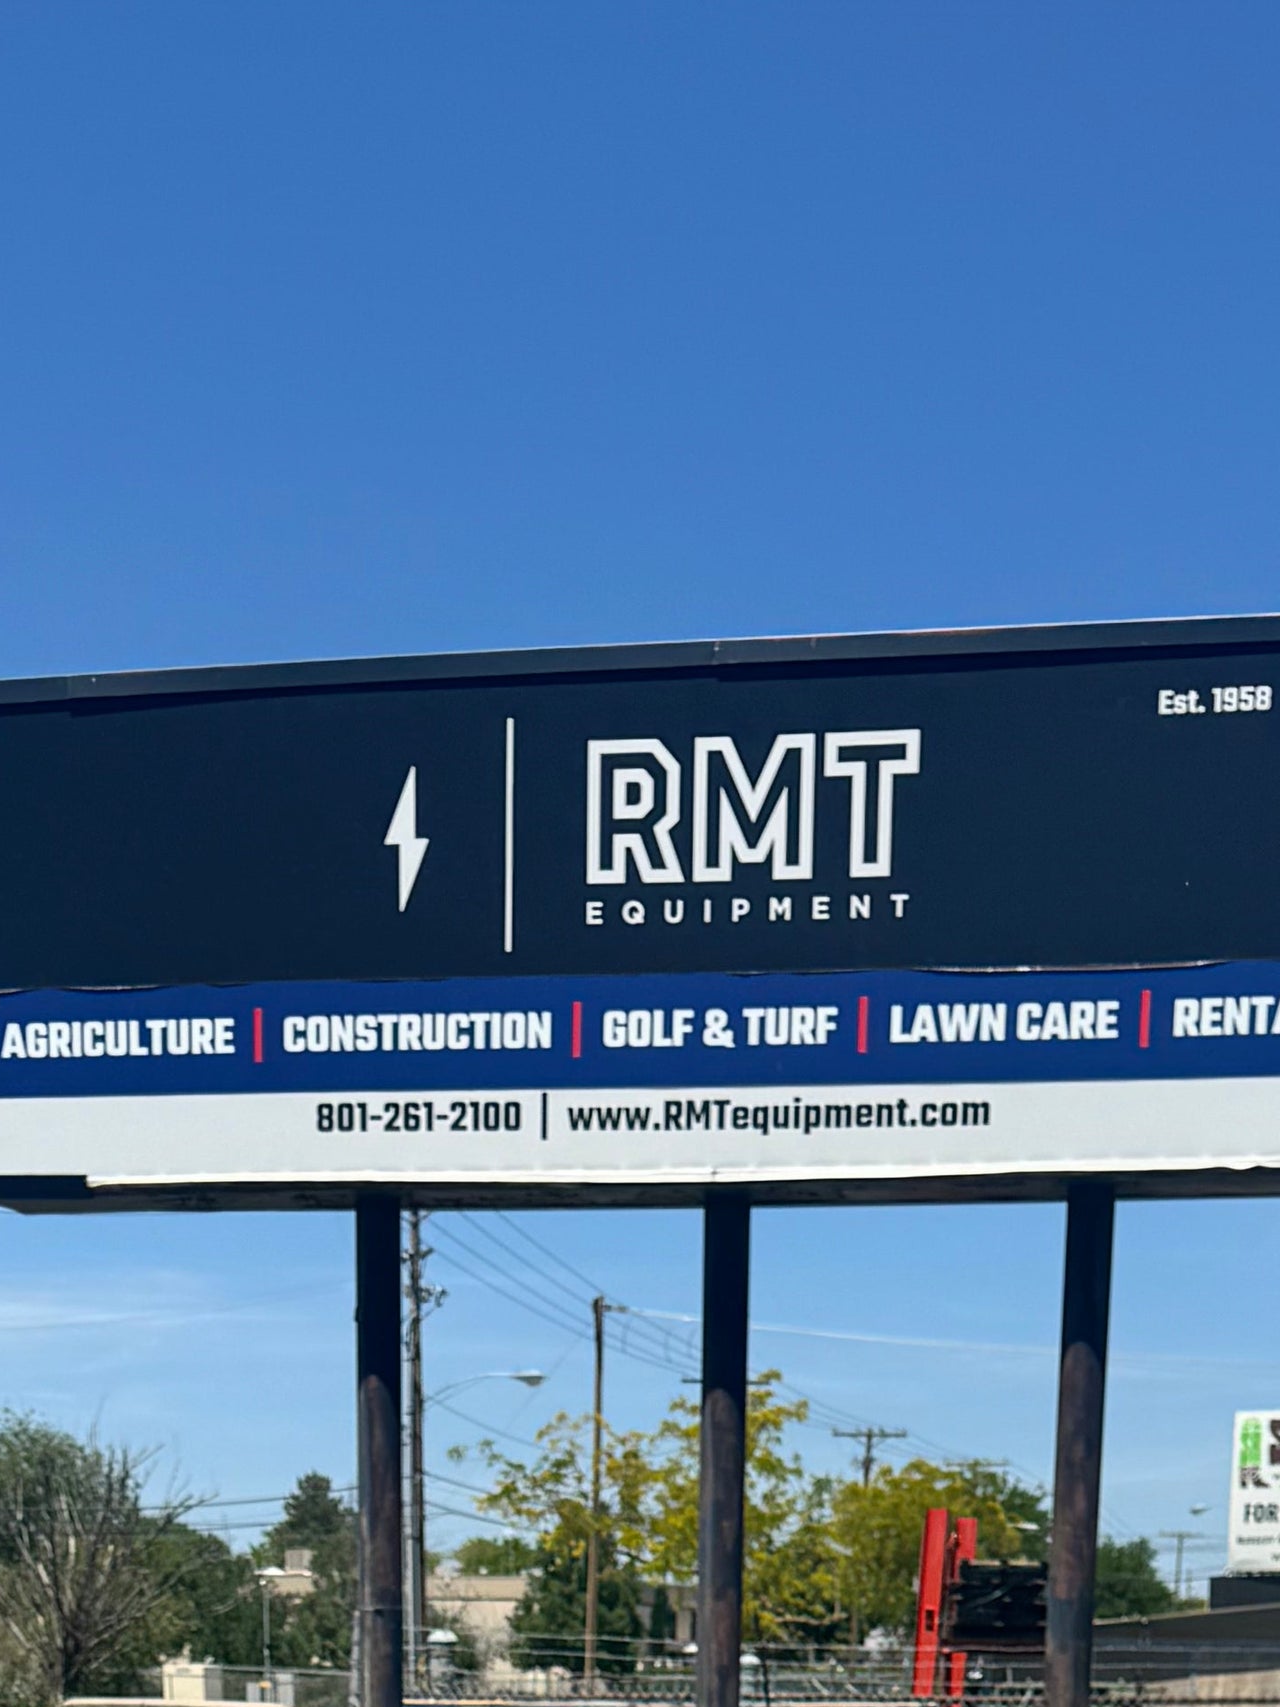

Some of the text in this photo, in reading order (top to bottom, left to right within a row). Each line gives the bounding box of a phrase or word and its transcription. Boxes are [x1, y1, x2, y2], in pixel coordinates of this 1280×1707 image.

[1158, 685, 1273, 715] Est. 1958
[585, 728, 921, 885] RMT
[585, 893, 910, 925] EQUIPMENT
[0, 1017, 236, 1059] AGRICULTURE
[283, 1011, 552, 1053] CONSTRUCTION
[602, 1009, 694, 1048] GOLF
[702, 1008, 736, 1048] &
[742, 1006, 839, 1046] TURF
[889, 1002, 1007, 1043] LAWN
[1016, 1000, 1120, 1041] CARE
[317, 1097, 990, 1136] 801-261-2100 www.RMTequipment.com
[1243, 1502, 1279, 1523] FOR
